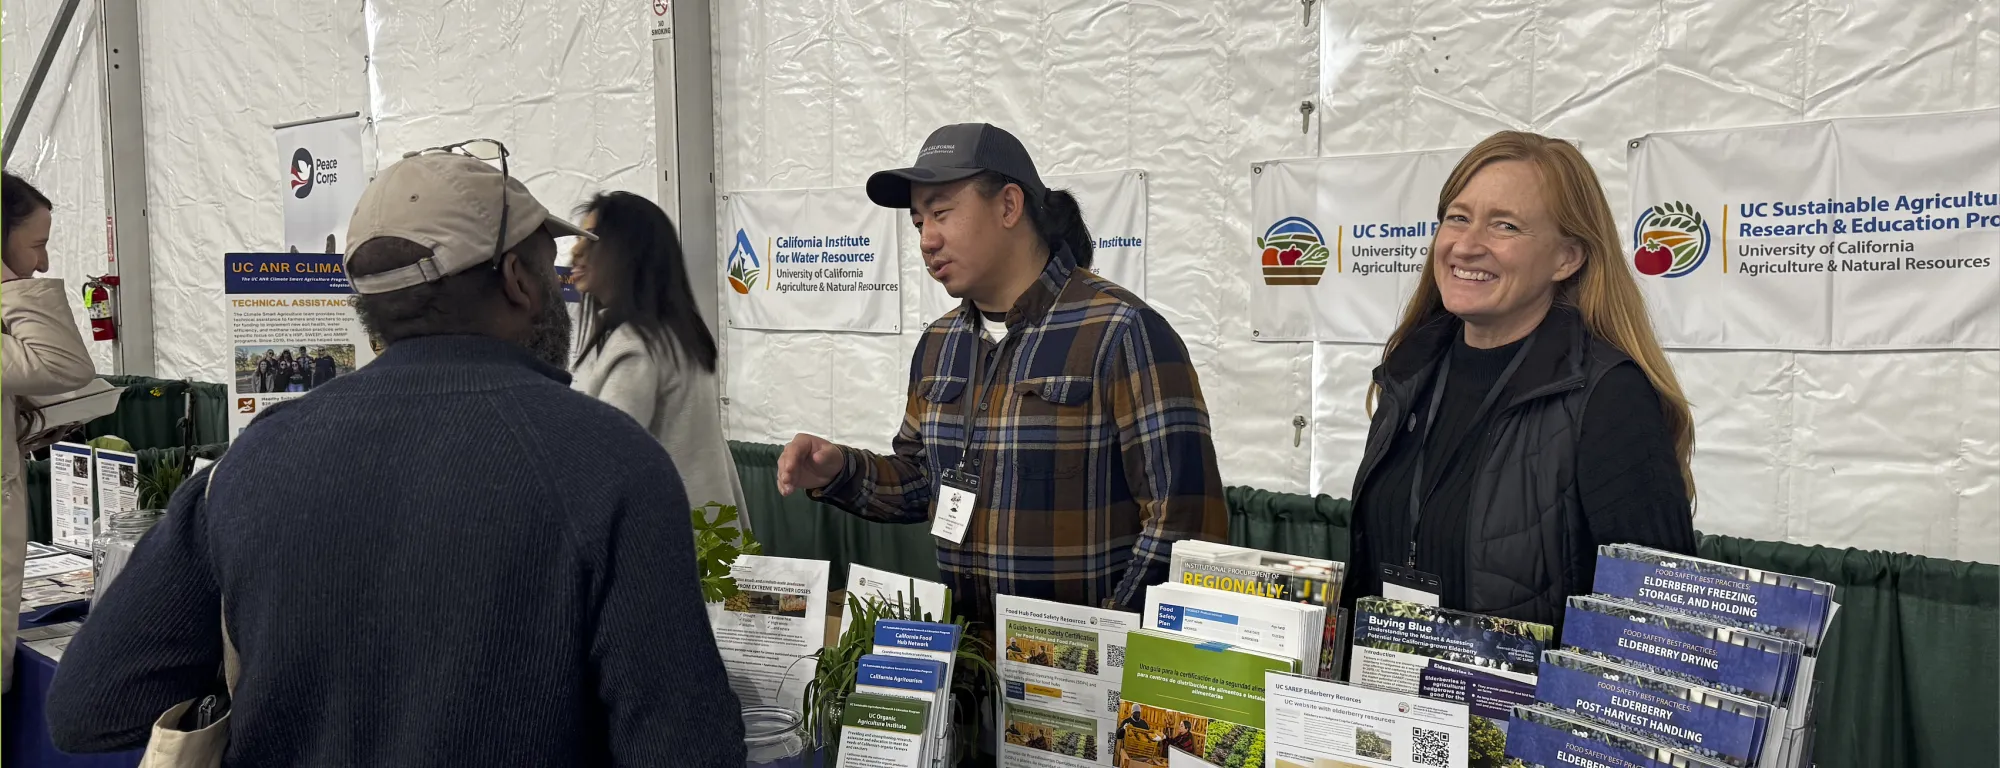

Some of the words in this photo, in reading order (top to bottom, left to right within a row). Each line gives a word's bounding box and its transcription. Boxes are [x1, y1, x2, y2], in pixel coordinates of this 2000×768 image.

[316, 159, 337, 170] Peace
[316, 172, 337, 186] Corps
[1740, 202, 1768, 218] UC
[1773, 196, 1889, 216] Sustainable
[1895, 191, 1998, 214] Agricultu
[1353, 224, 1376, 238] UC
[1380, 222, 1426, 237] Small
[1740, 219, 1828, 237] Research
[1833, 219, 1847, 234] &
[1852, 214, 1959, 233] Education
[776, 236, 822, 248] California
[825, 235, 870, 247] Institute
[1099, 236, 1142, 248] Institute
[1739, 243, 1815, 258] University
[1820, 242, 1834, 254] of
[1838, 240, 1914, 254] California
[776, 252, 789, 263] for
[791, 252, 819, 263] Water
[821, 252, 875, 263] Resources
[1352, 245, 1417, 259] University
[232, 262, 254, 272] UC
[259, 263, 290, 272] ANR
[295, 263, 342, 273] CLIMA
[777, 269, 813, 280] University
[814, 269, 822, 278] of
[824, 268, 863, 278] California
[1352, 261, 1423, 276] Agriculture
[1739, 260, 1823, 277] Agriculture
[1827, 260, 1837, 272] &
[1842, 257, 1900, 271] Natural
[1906, 257, 1990, 270] Resources
[776, 282, 817, 293] Agriculture
[820, 282, 824, 291] &
[827, 282, 856, 292] Natural
[858, 282, 898, 291] Resources
[1184, 562, 1226, 573] INSTITUTIONAL
[1228, 568, 1271, 579] PROCUREMENT
[1183, 572, 1288, 598] REGIONALLY-
[1656, 569, 1674, 577] FOOD
[1675, 572, 1698, 582] SAFETY
[1699, 575, 1714, 584] BEST
[1715, 578, 1751, 590] PRACTICES:
[1644, 576, 1706, 595] ELDERBERRY
[1708, 588, 1758, 605] FREEZING,
[1639, 588, 1685, 605] STORAGE,
[1688, 598, 1709, 608] AND
[1712, 602, 1758, 618] HOLDING
[1043, 614, 1059, 622] Safety
[1060, 616, 1086, 624] Resources
[1159, 613, 1176, 621] Safety
[1369, 616, 1405, 630] Buying
[1408, 622, 1432, 633] Blue
[1048, 629, 1064, 638] Safety
[1065, 632, 1096, 642] Certification
[1368, 626, 1408, 637] Understanding
[1420, 633, 1439, 641] Market
[1446, 638, 1474, 647] Assessing
[1624, 629, 1641, 638] FOOD
[1643, 632, 1665, 643] SAFETY
[1666, 638, 1682, 647] BEST
[1682, 642, 1718, 656] PRACTICES:
[1364, 649, 1395, 658] Introduction
[1402, 638, 1447, 650] California-grown
[1449, 645, 1477, 655] Elderberry
[1618, 638, 1679, 660] ELDERBERRY
[1681, 652, 1719, 669] DRYING
[894, 675, 922, 684] Agritourism
[1177, 679, 1208, 690] distribución
[1217, 686, 1242, 697] alimentos
[1180, 671, 1211, 682] certificación
[1226, 680, 1251, 690] seguridad
[1433, 682, 1466, 690] agricultural
[1192, 689, 1223, 700] alimentarias
[1304, 689, 1334, 700] Elderberry
[1336, 694, 1361, 703] Resorces
[1597, 682, 1615, 692] FOOD
[1617, 686, 1639, 697] SAFETY
[1640, 693, 1655, 701] BEST
[1656, 697, 1692, 712] PRACTICES:
[1294, 701, 1317, 710] website
[1332, 708, 1363, 719] elderberry
[1364, 715, 1396, 724] resources
[1611, 696, 1672, 720] ELDERBERRY
[858, 719, 884, 727] Agriculture
[1576, 699, 1648, 727] POST-HARVEST
[1650, 720, 1702, 743] HANDLING
[1557, 750, 1613, 768] ELDERBE
[1566, 743, 1584, 753] FOOD
[1585, 749, 1607, 760] SAFETY
[1608, 756, 1623, 765] BEST
